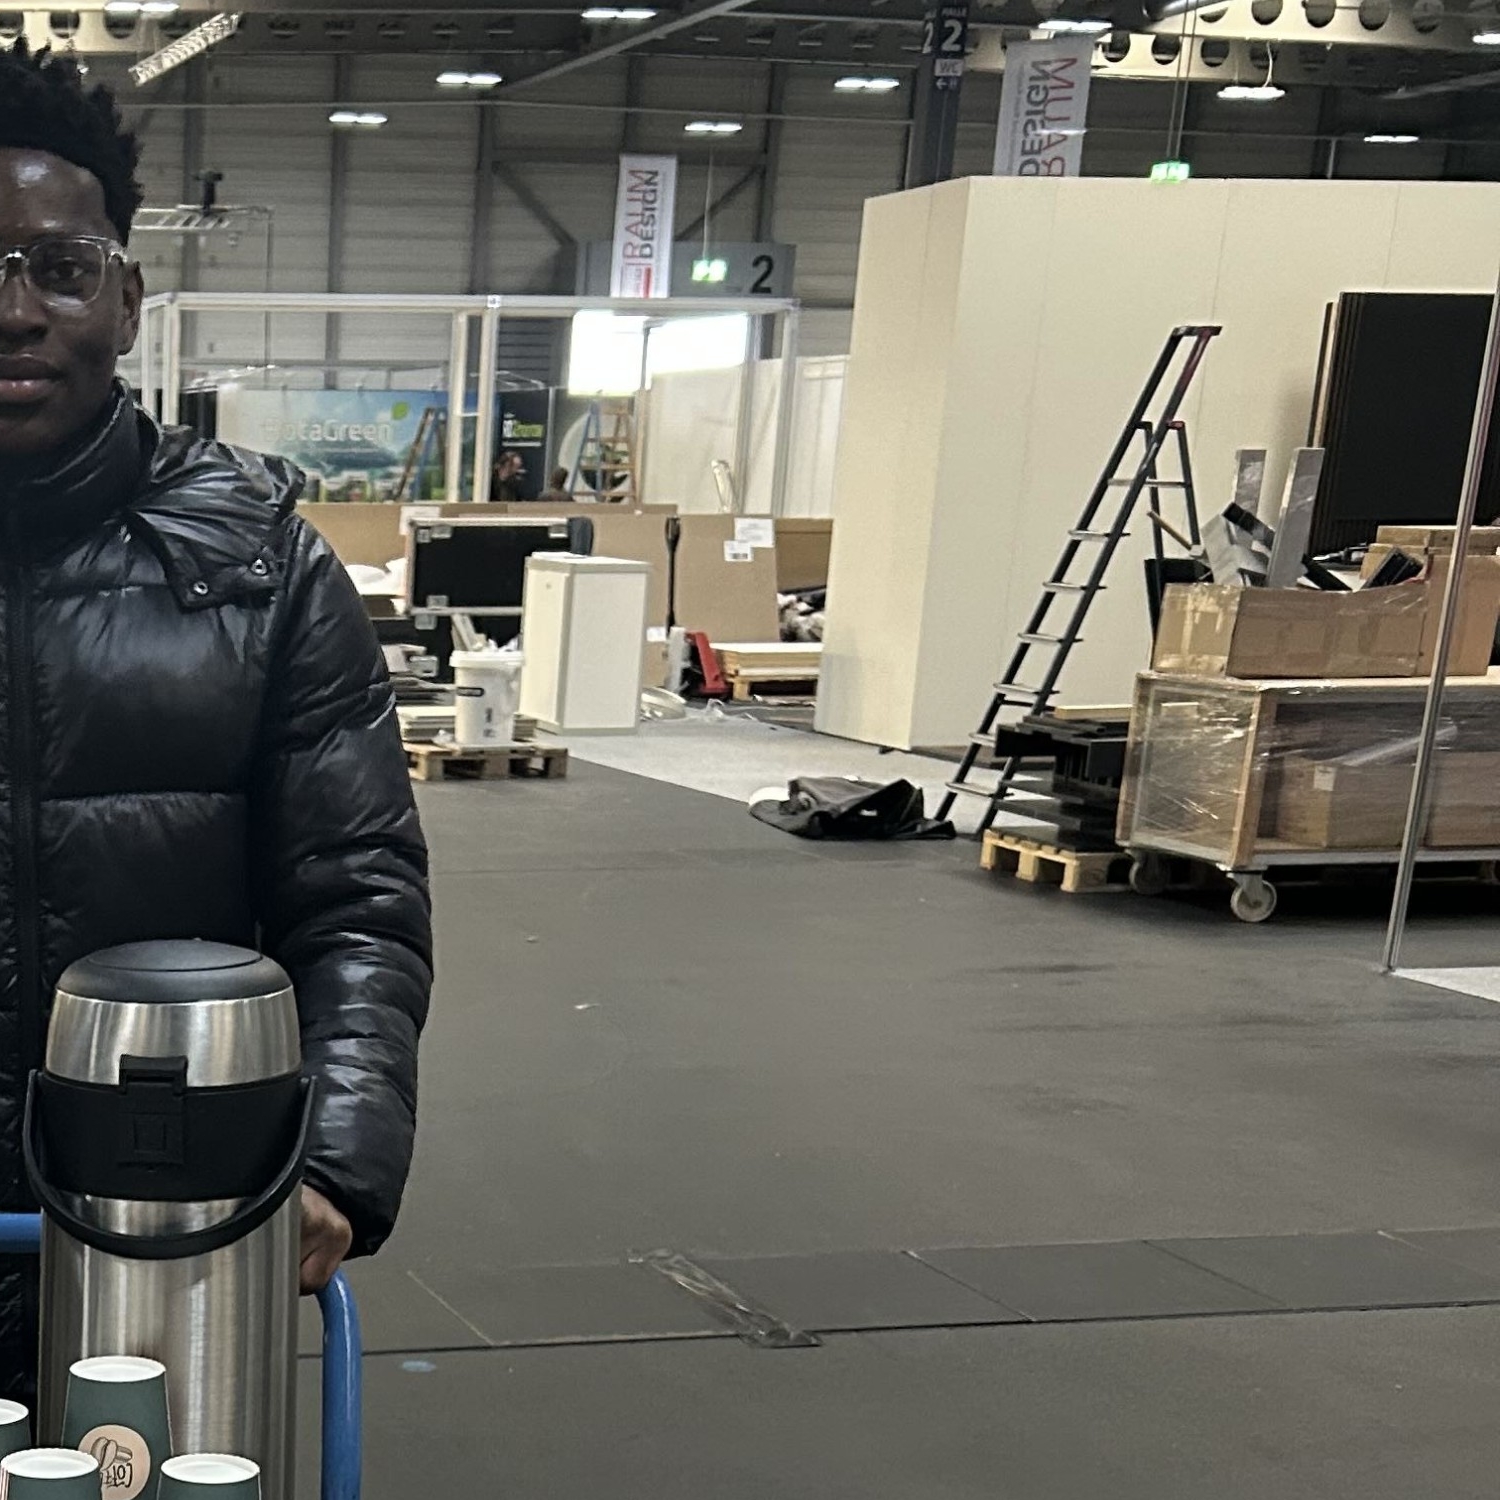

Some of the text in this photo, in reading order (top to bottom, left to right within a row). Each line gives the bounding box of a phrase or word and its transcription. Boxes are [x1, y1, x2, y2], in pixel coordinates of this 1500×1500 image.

[941, 19, 962, 52] 2
[940, 61, 959, 73] WC
[622, 170, 645, 259] RAUM
[638, 170, 659, 259] DESIGN
[750, 255, 773, 293] 2
[102, 1462, 133, 1489] COFF
